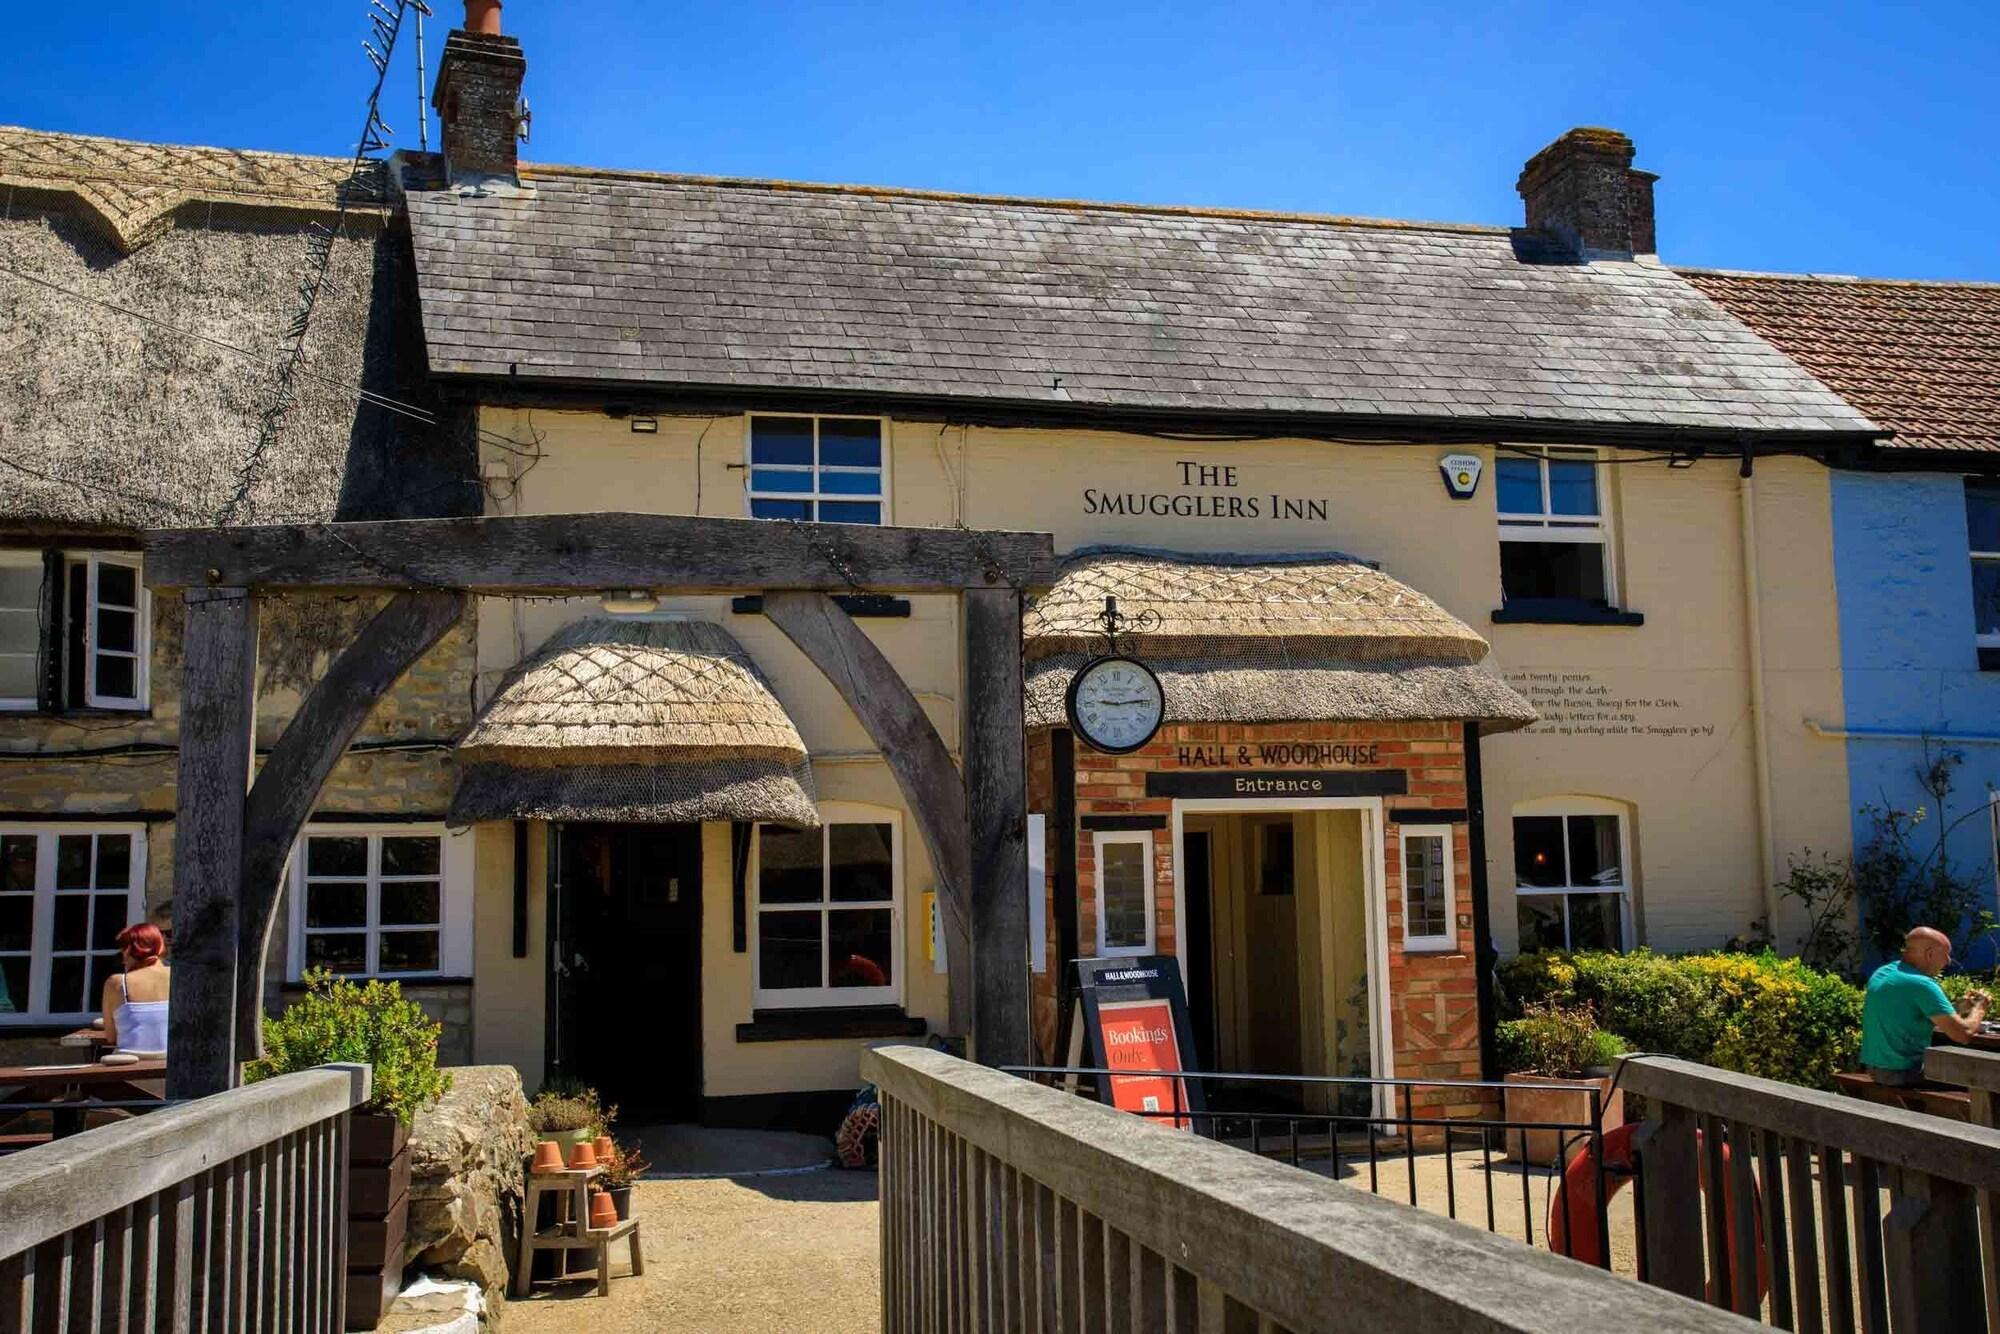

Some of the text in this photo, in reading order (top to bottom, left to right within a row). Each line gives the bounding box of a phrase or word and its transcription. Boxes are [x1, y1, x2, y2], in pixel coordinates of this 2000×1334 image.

[1176, 461, 1238, 487] THE
[1083, 488, 1329, 521] SMUGGLERS INN
[1529, 672, 1557, 683] twenty
[1530, 685, 1564, 698] through
[1568, 685, 1581, 695] the
[1532, 698, 1544, 708] for
[1547, 698, 1561, 708] the
[1625, 698, 1638, 708] for
[1639, 698, 1652, 708] the
[1597, 712, 1609, 721] for
[1559, 727, 1572, 737] my
[1575, 725, 1604, 737] darling
[1606, 725, 1628, 734] while
[1646, 725, 1688, 737] Smugglers
[1690, 728, 1701, 737] go
[1178, 744, 1380, 767] HALL & WOODHOUSE
[1235, 778, 1323, 793] Entrance
[1108, 1026, 1169, 1046] Bookings
